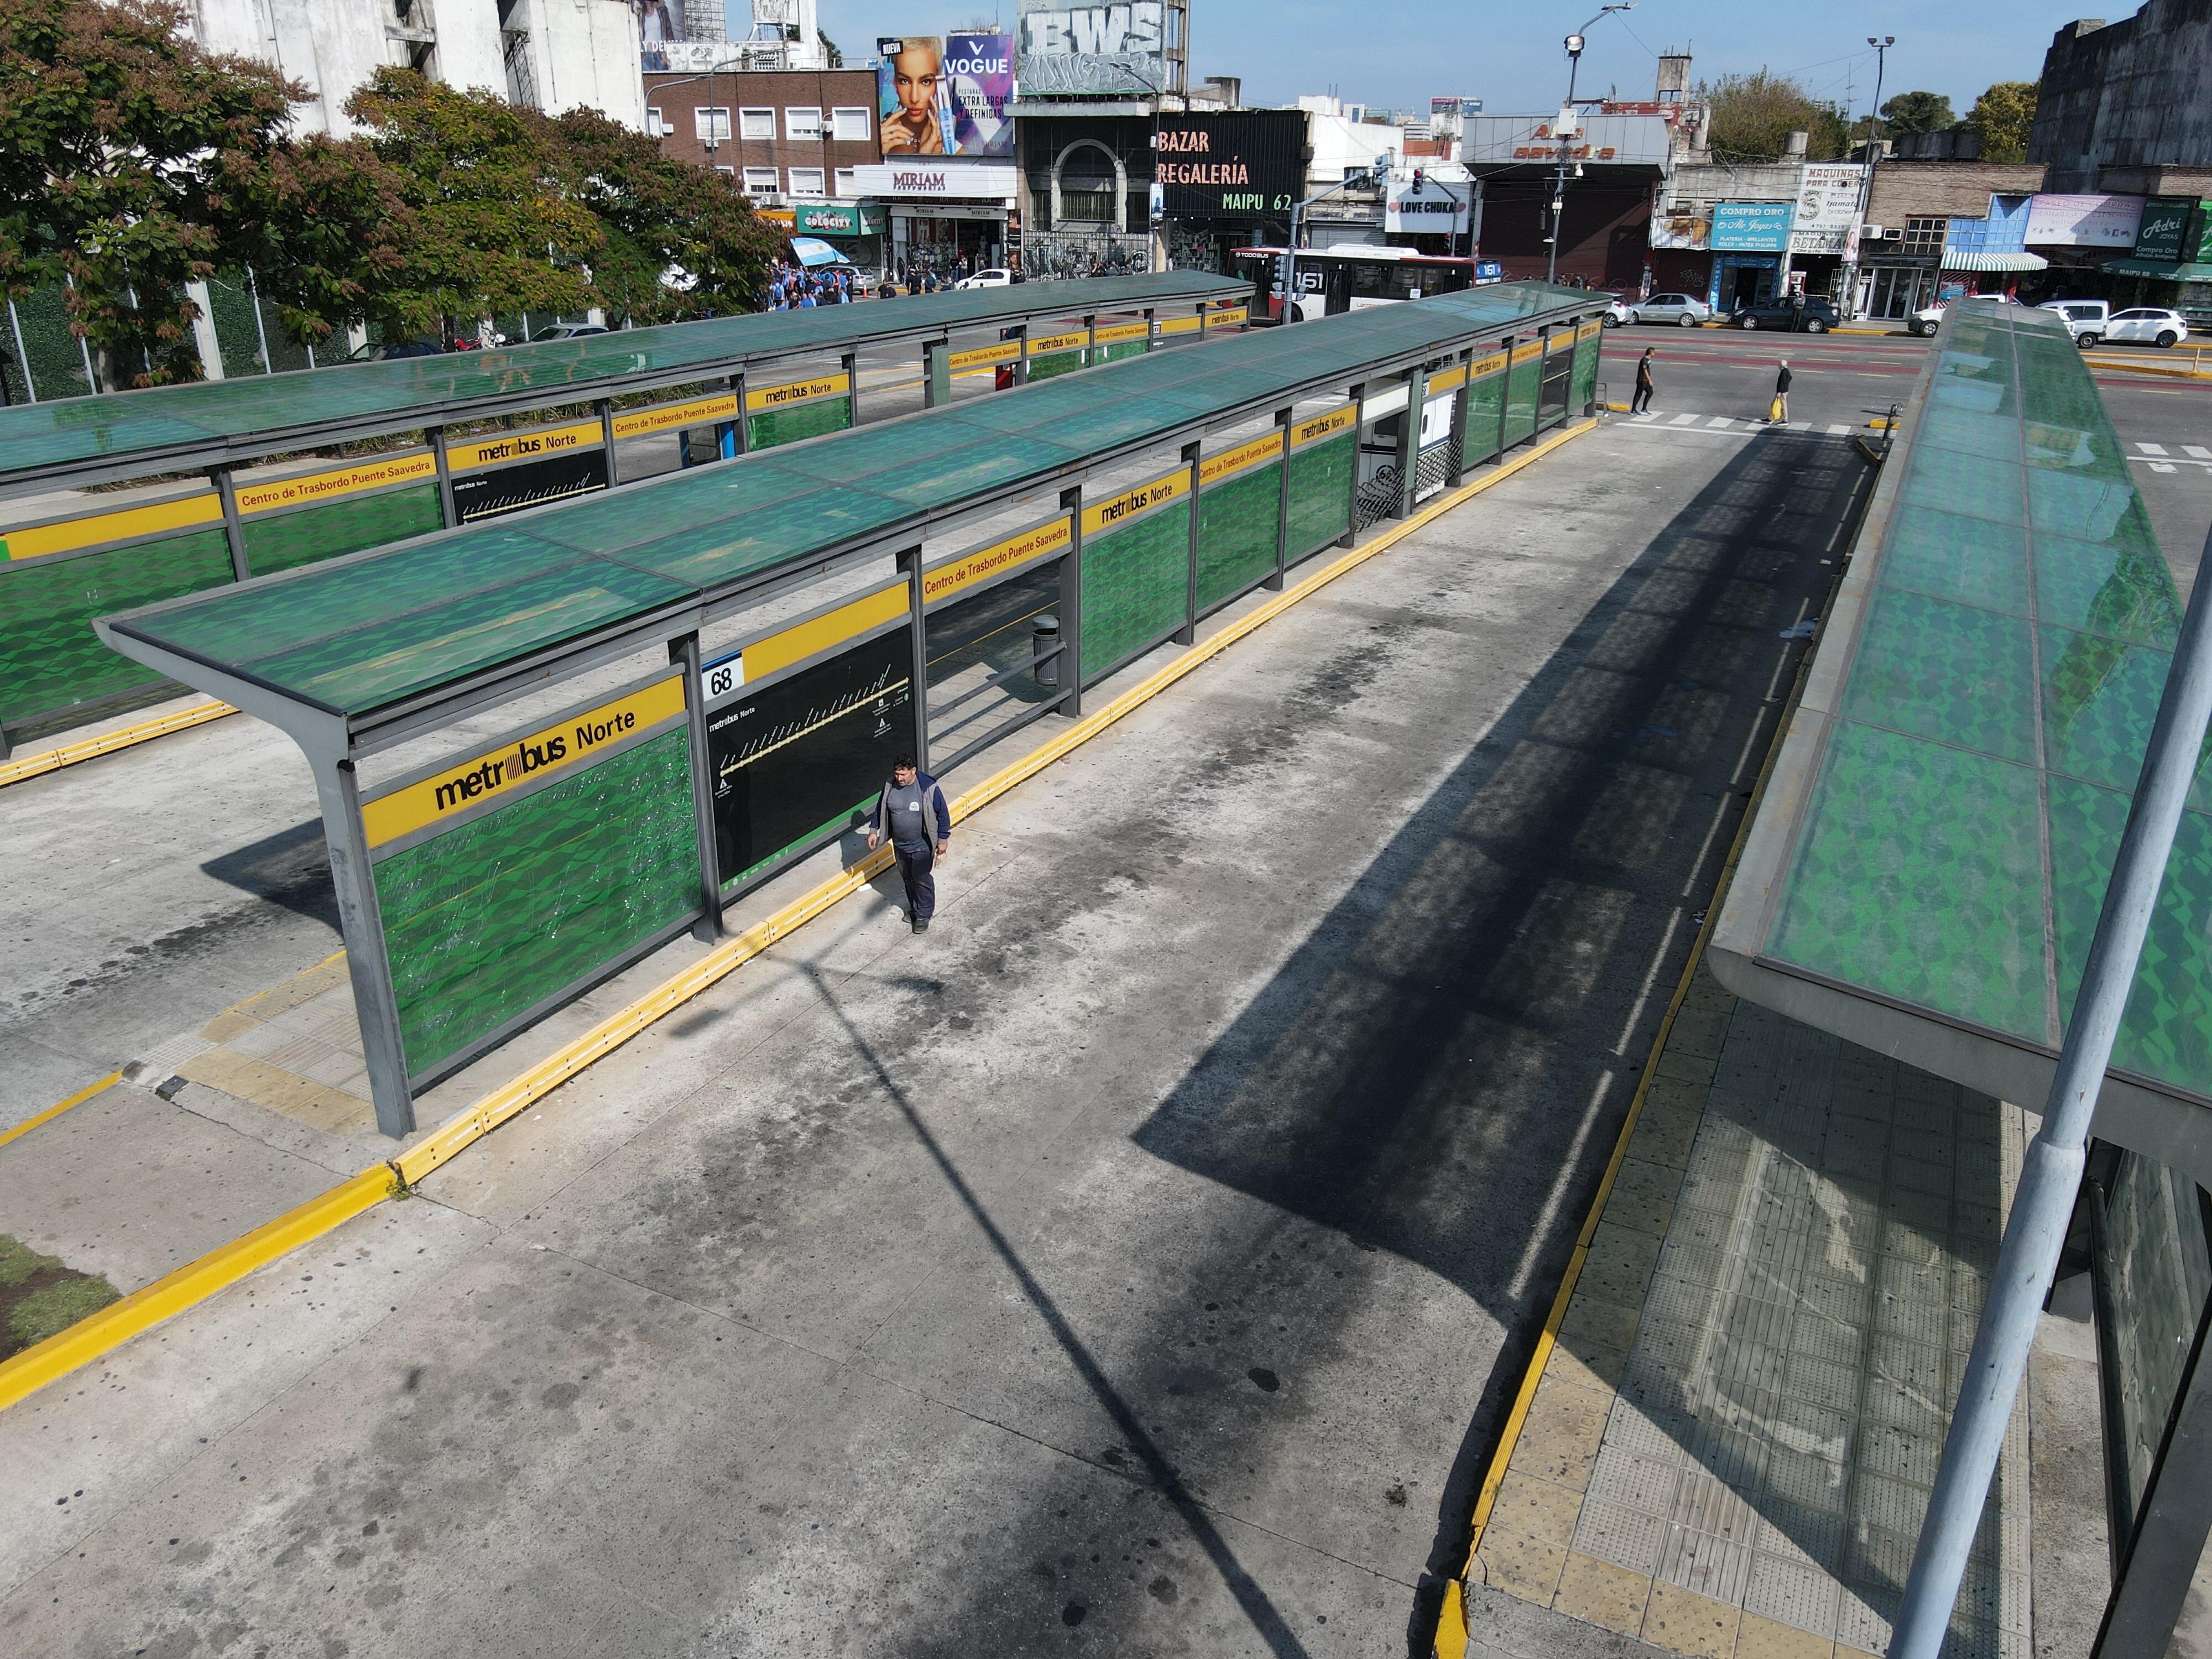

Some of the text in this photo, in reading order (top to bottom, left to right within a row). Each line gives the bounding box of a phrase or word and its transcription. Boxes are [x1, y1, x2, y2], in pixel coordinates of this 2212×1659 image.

[883, 43, 901, 54] NUEVA
[945, 59, 1008, 74] VOGUE
[959, 96, 1008, 106] EXTRA LARGAS
[959, 108, 1001, 119] Y DEFINIDAS
[1159, 132, 1209, 152] BAZAR
[1157, 155, 1248, 185] REGALERÍA
[1809, 169, 1860, 178] MAQUINAS
[893, 173, 945, 186] MIRIAM
[1223, 194, 1291, 211] MAIPU 62
[1401, 202, 1455, 213] LOVE CHUKA
[2089, 200, 2137, 208] COMPRAS
[2143, 218, 2181, 238] Adri
[1791, 237, 1846, 249] BETAMA
[1484, 265, 1495, 275] 161
[1296, 272, 1323, 289] 161
[811, 383, 831, 395] Norte
[616, 402, 734, 433] Centro de Trasbordo Puente Saavedra
[1331, 416, 1345, 429] Norte
[546, 435, 576, 448] Norte
[1199, 466, 1215, 479] Centro
[1223, 454, 1246, 469] Trasbordo
[1247, 449, 1261, 460] Puente
[242, 462, 430, 506] Centro de Trasbordo Puente Saavedra
[1151, 485, 1172, 502] Norte
[925, 528, 1067, 594] Centro de Trasbordo Puente Saavedra
[711, 667, 732, 696] 68
[740, 707, 755, 719] Norte
[576, 712, 635, 750] Norte
